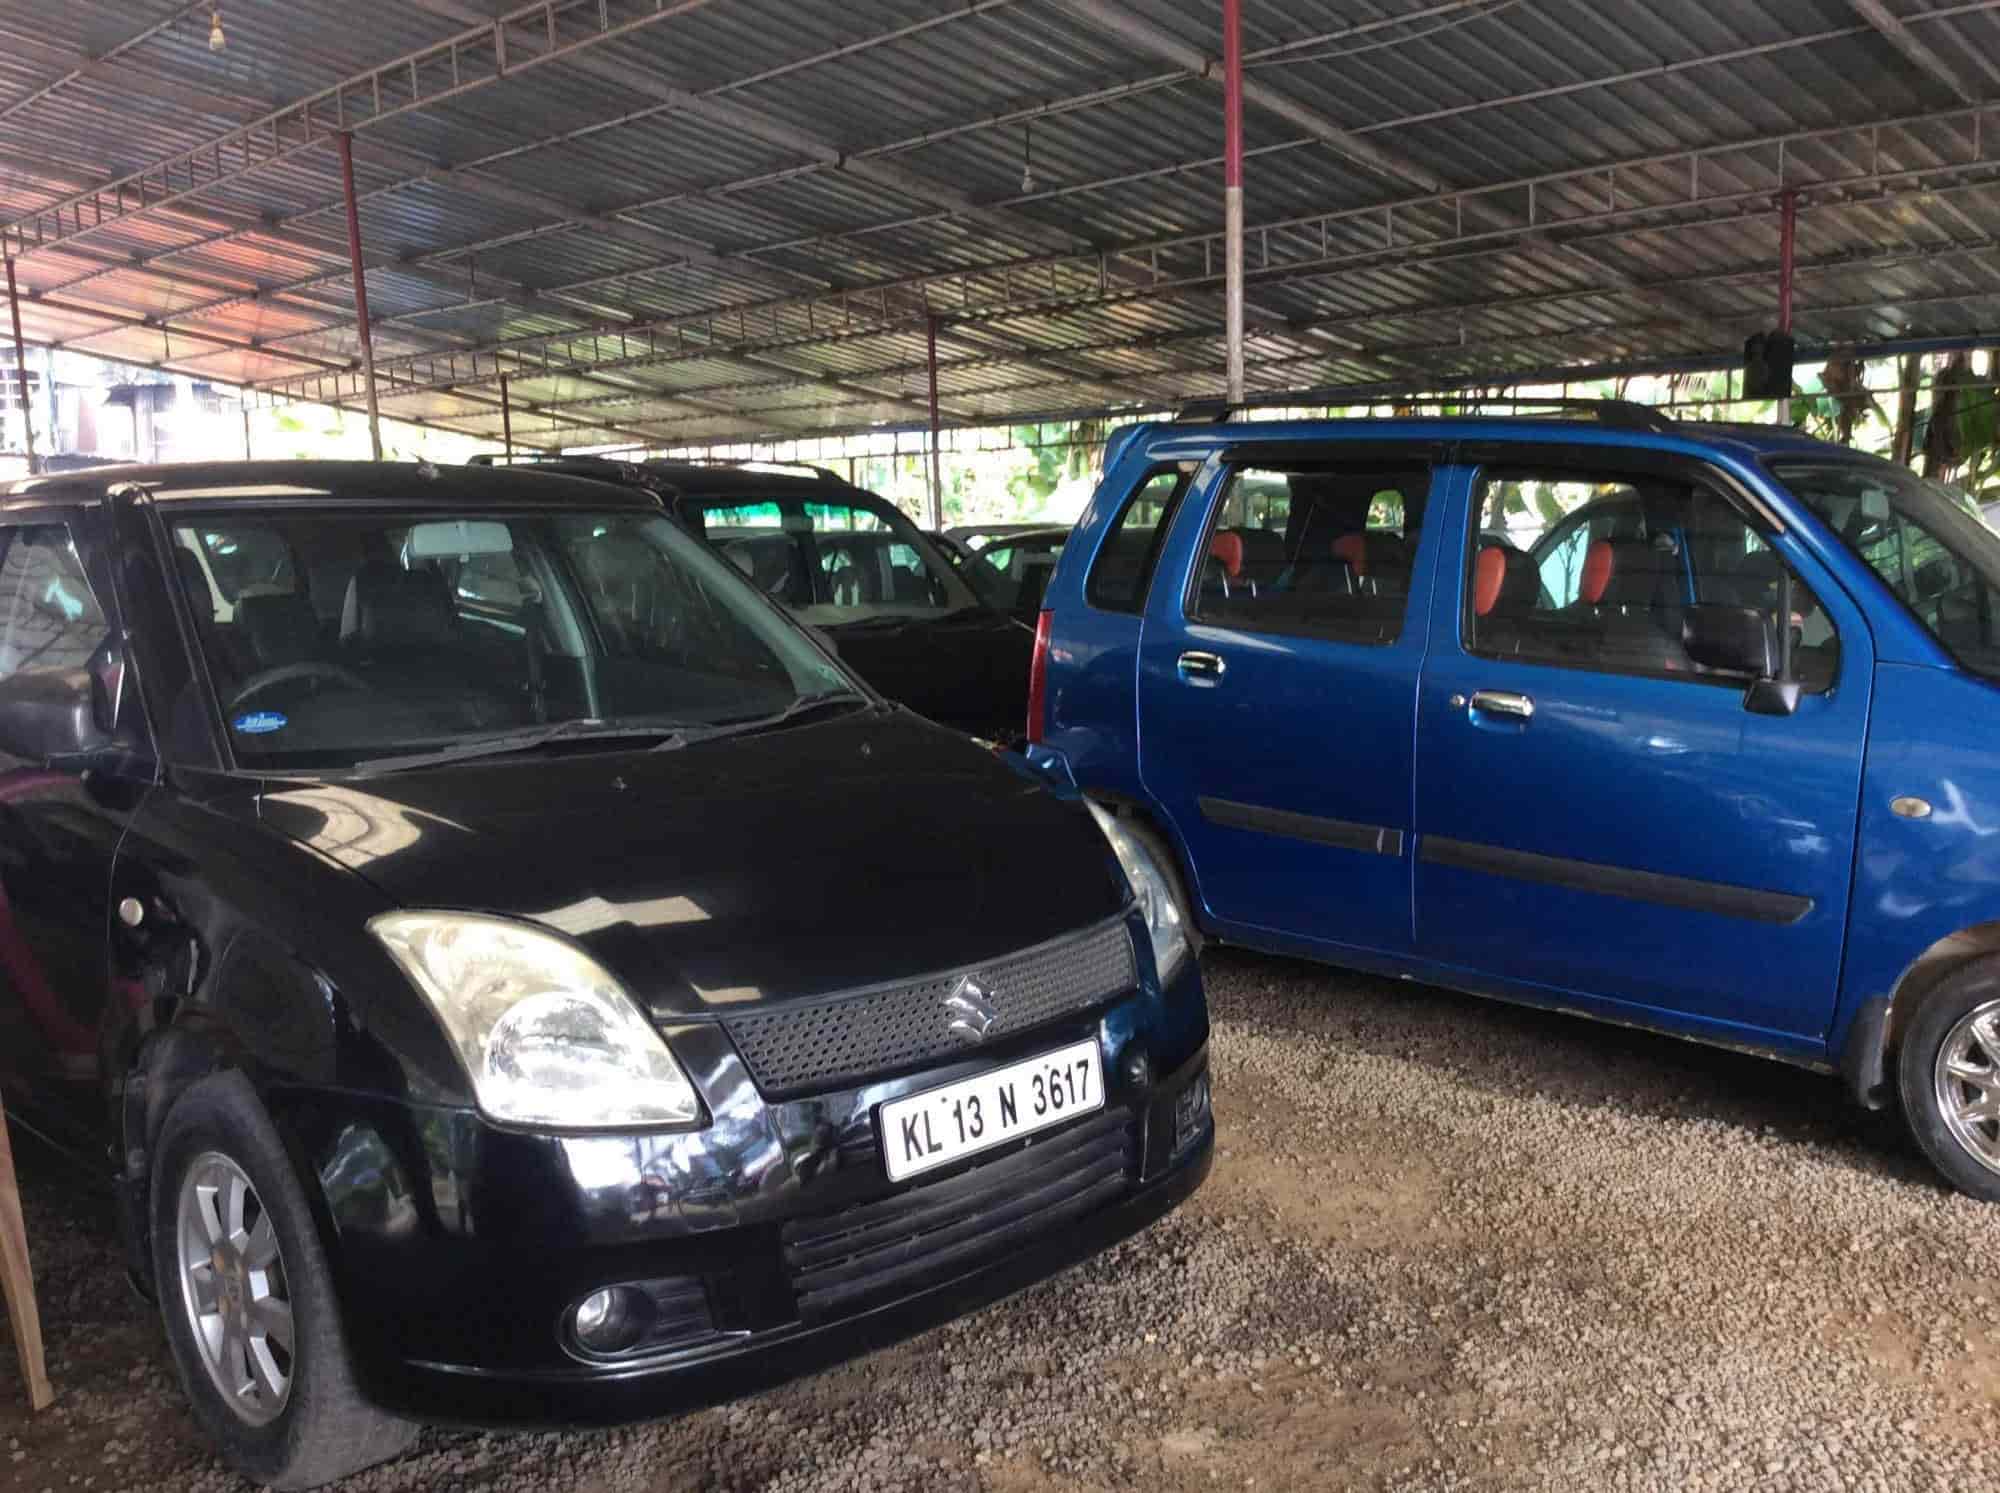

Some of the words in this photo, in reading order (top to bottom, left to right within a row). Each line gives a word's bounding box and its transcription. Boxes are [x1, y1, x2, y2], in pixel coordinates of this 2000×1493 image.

[901, 1109, 943, 1162] KL
[953, 1095, 984, 1143] 13
[999, 1082, 1018, 1128] N
[1032, 1059, 1089, 1116] 3617
